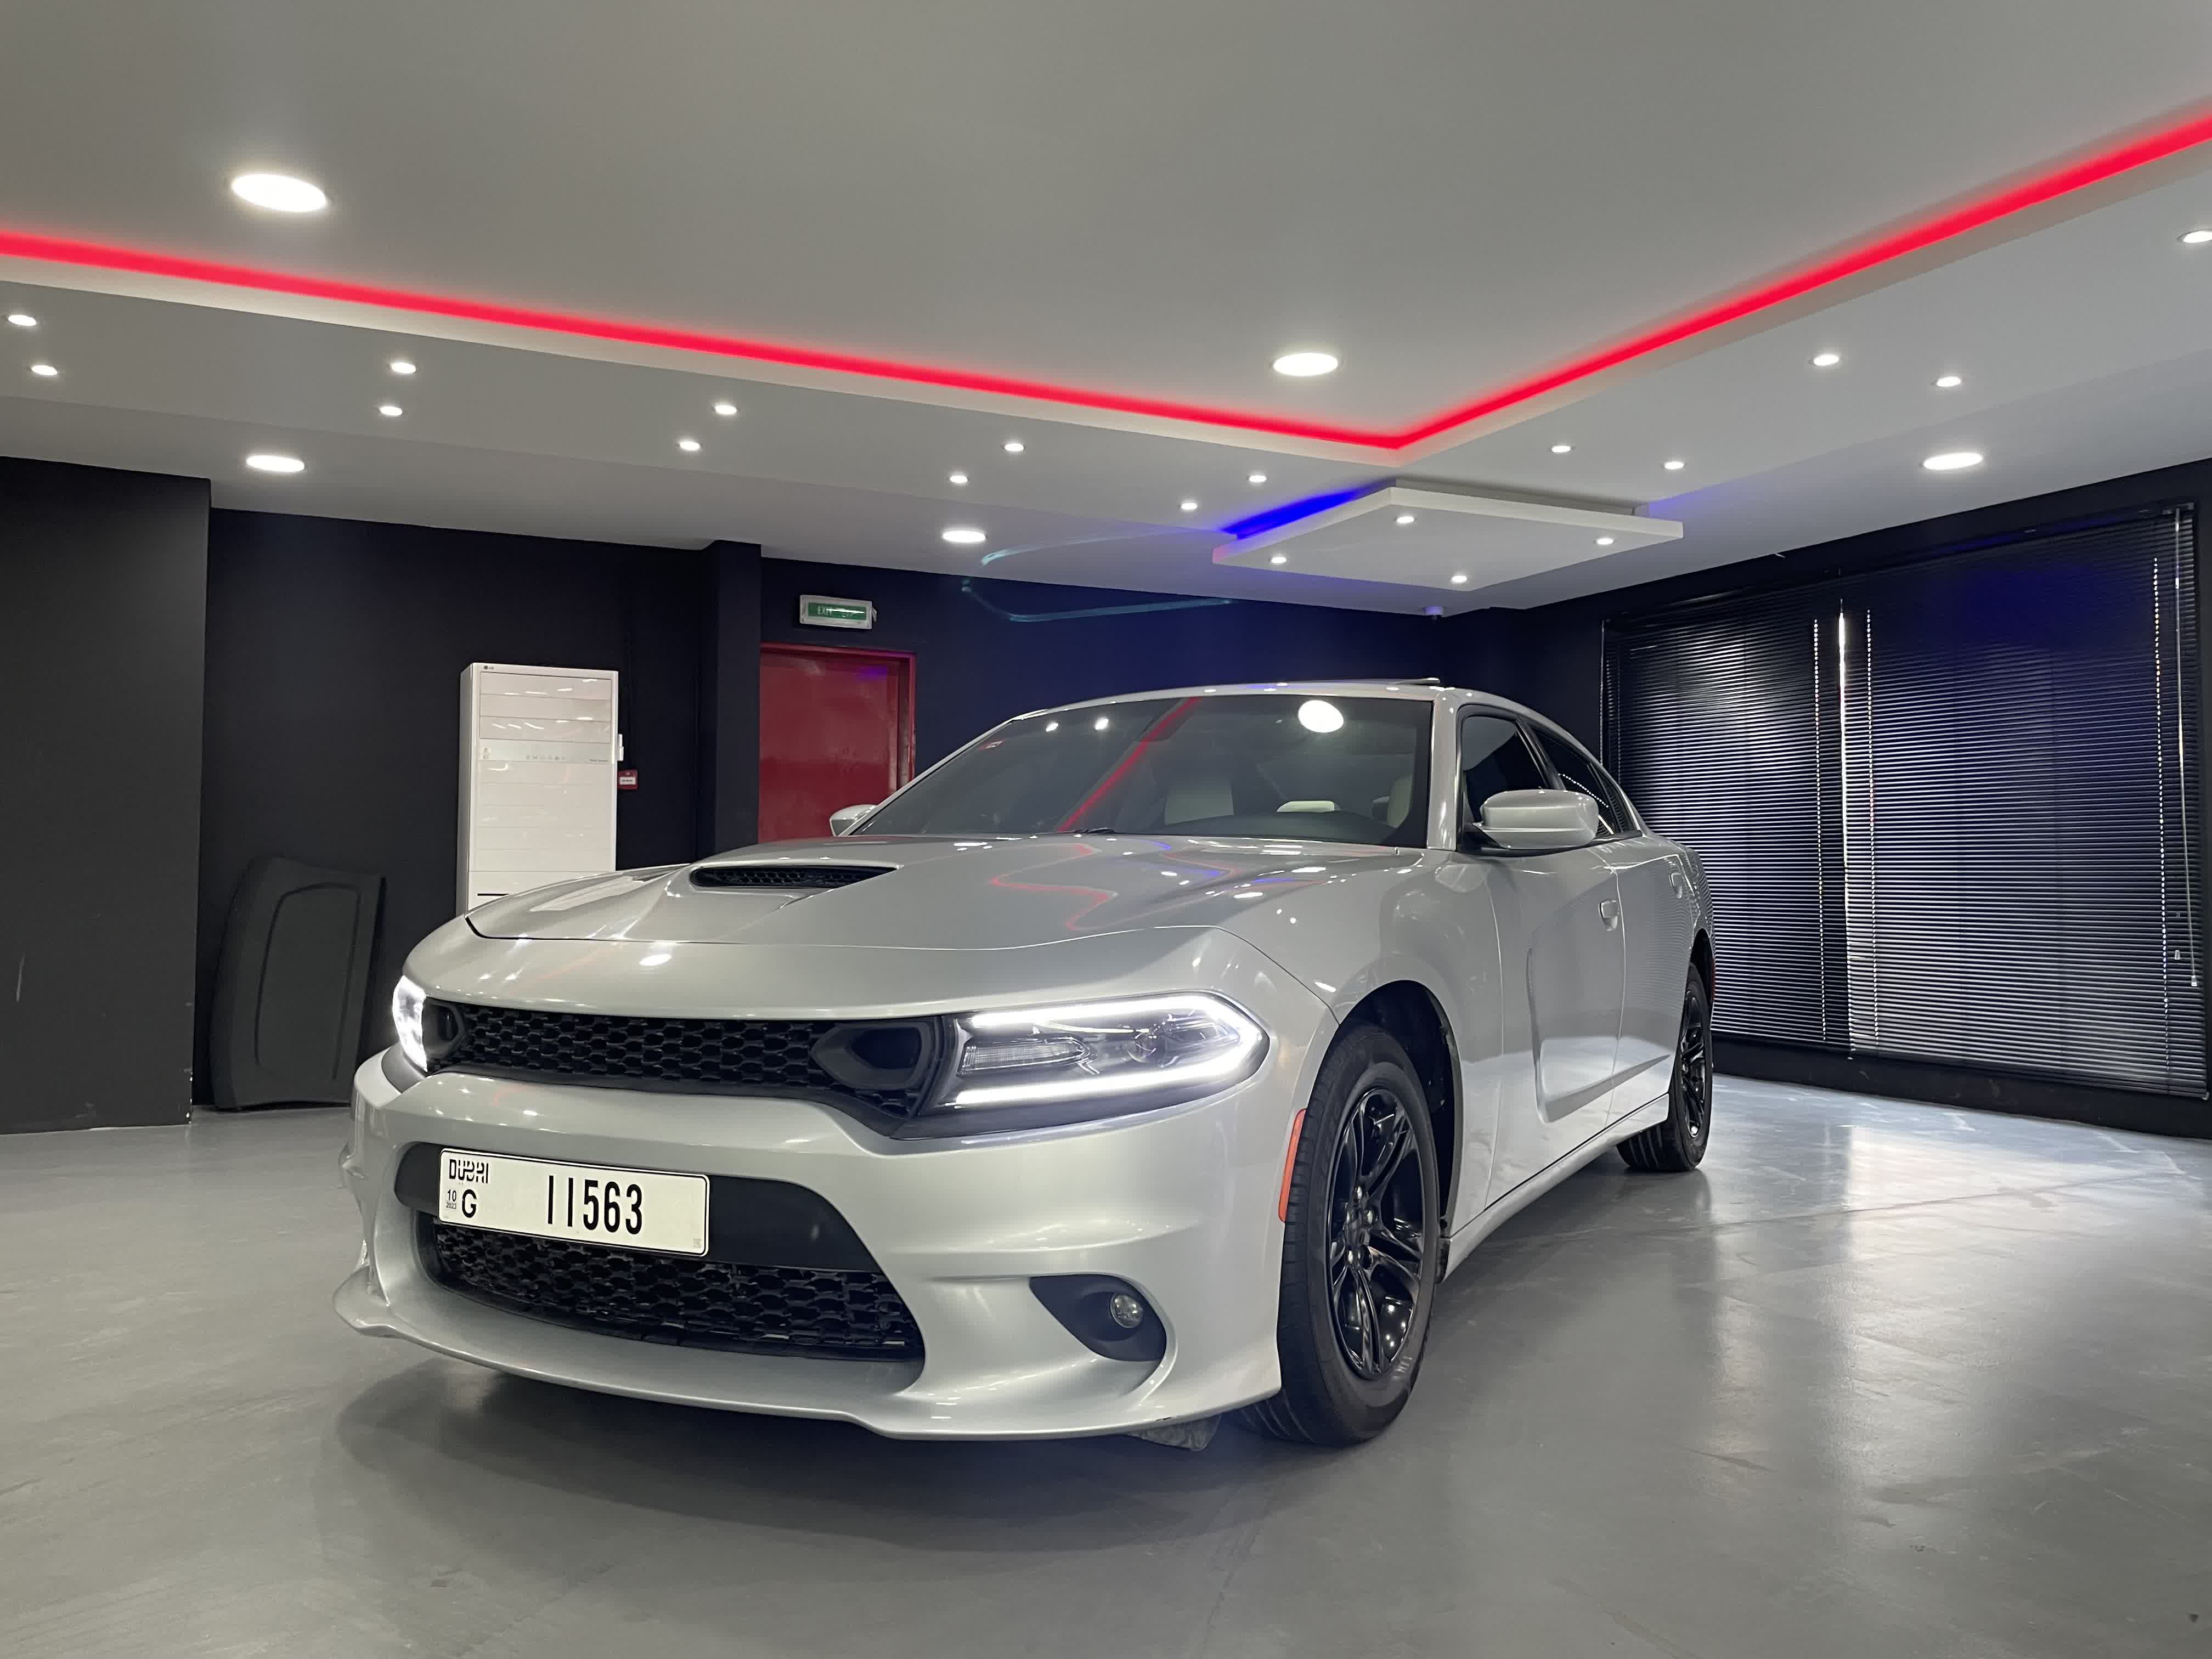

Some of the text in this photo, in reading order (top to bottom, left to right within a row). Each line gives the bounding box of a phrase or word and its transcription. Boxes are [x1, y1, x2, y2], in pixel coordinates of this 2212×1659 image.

[447, 1189, 456, 1201] 10
[462, 1189, 477, 1218] G
[548, 1175, 642, 1234] 11563
